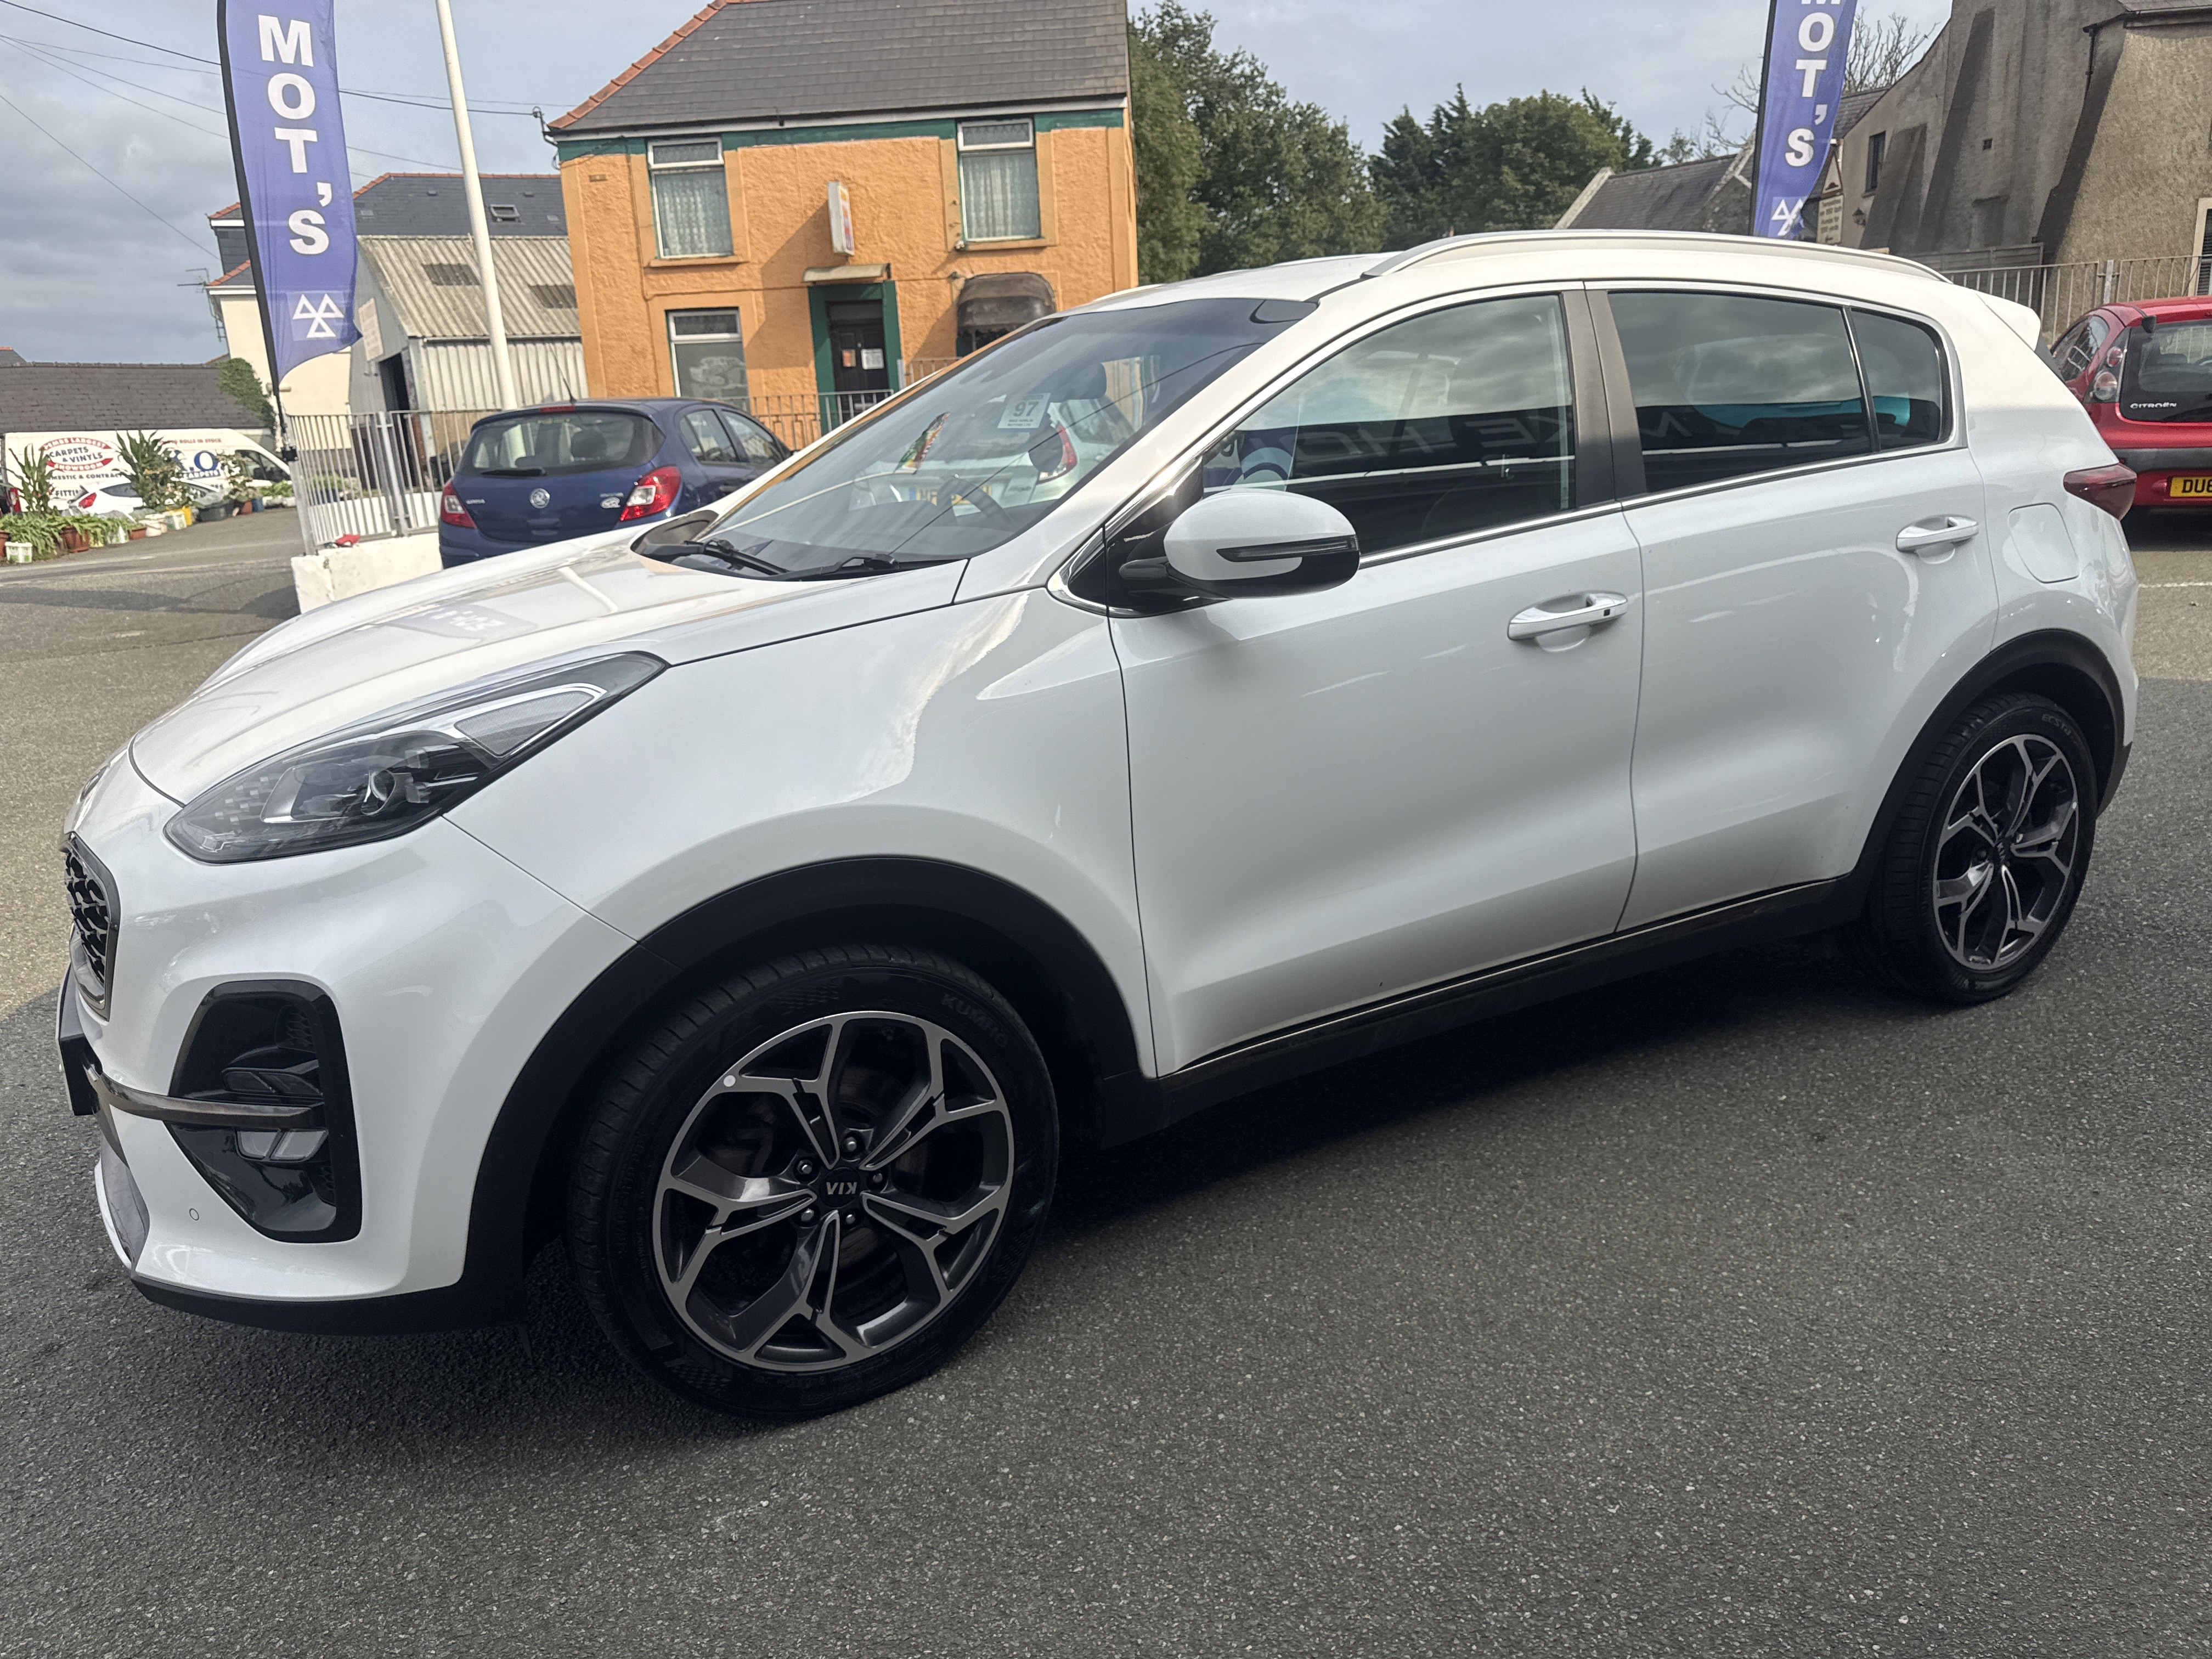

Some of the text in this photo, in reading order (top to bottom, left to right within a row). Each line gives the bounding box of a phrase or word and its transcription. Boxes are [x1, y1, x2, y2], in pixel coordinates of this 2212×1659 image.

[1785, 0, 1841, 167] OT'S
[258, 14, 332, 255] MOT'S
[1013, 401, 1040, 417] 97
[49, 446, 89, 458] CARPETS
[70, 452, 103, 463] VINYLS
[826, 1181, 857, 1195] KIA
